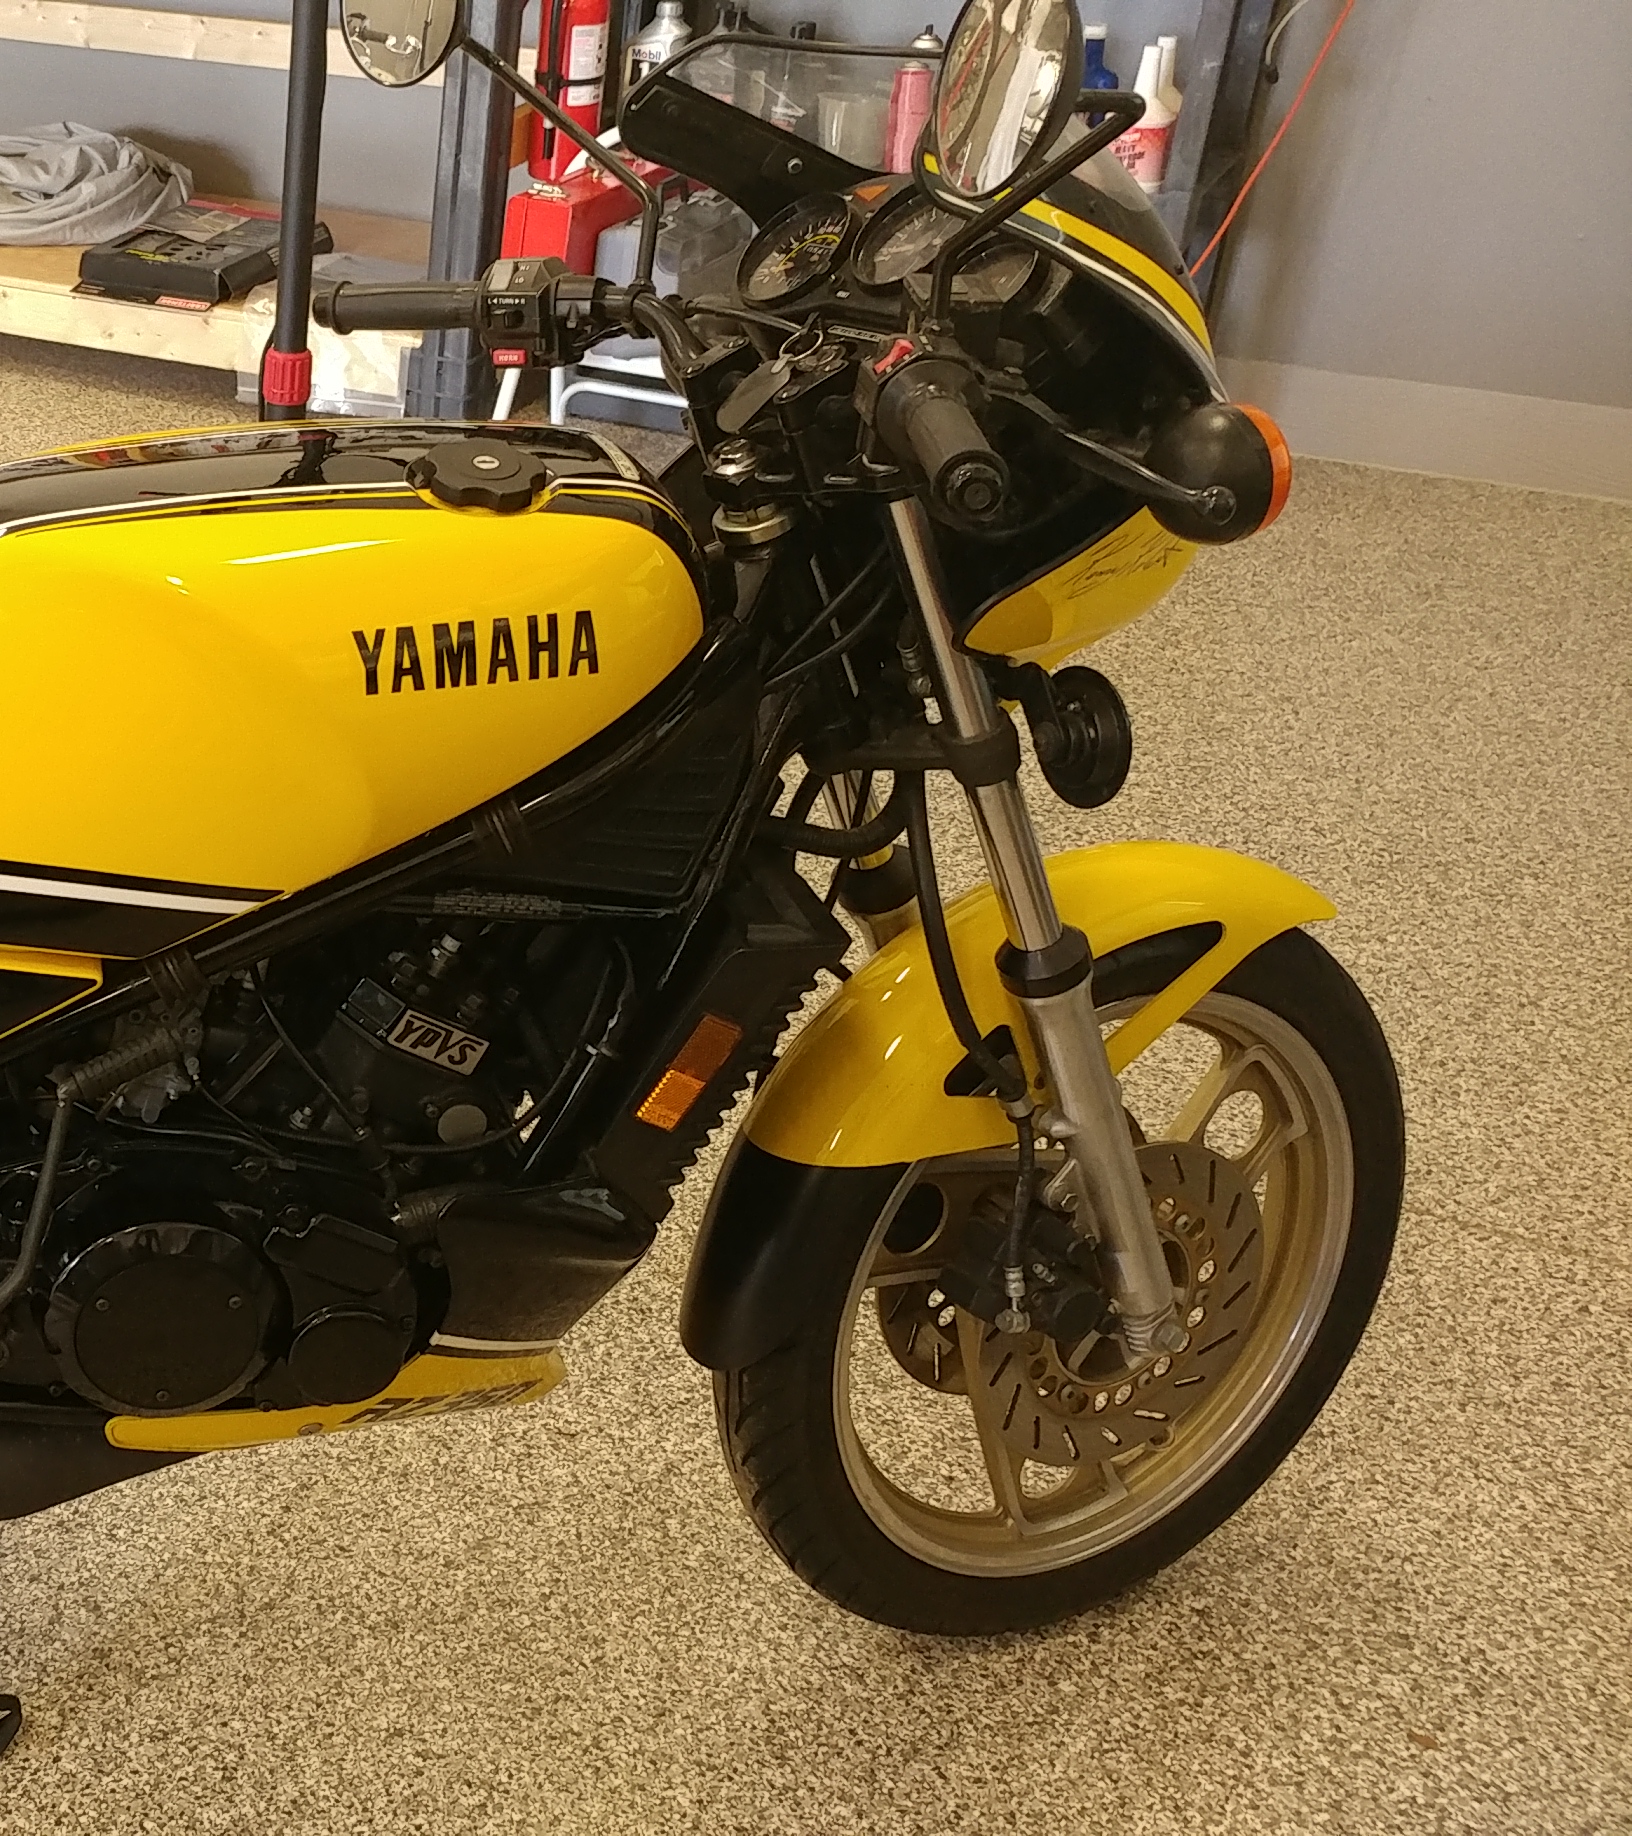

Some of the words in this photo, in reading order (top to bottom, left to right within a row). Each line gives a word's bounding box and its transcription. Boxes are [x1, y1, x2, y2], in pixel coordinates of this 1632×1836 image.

[632, 48, 662, 61] Mobil
[638, 62, 650, 79] 1
[351, 610, 599, 696] YAMAHA
[393, 1013, 485, 1066] YPVS
